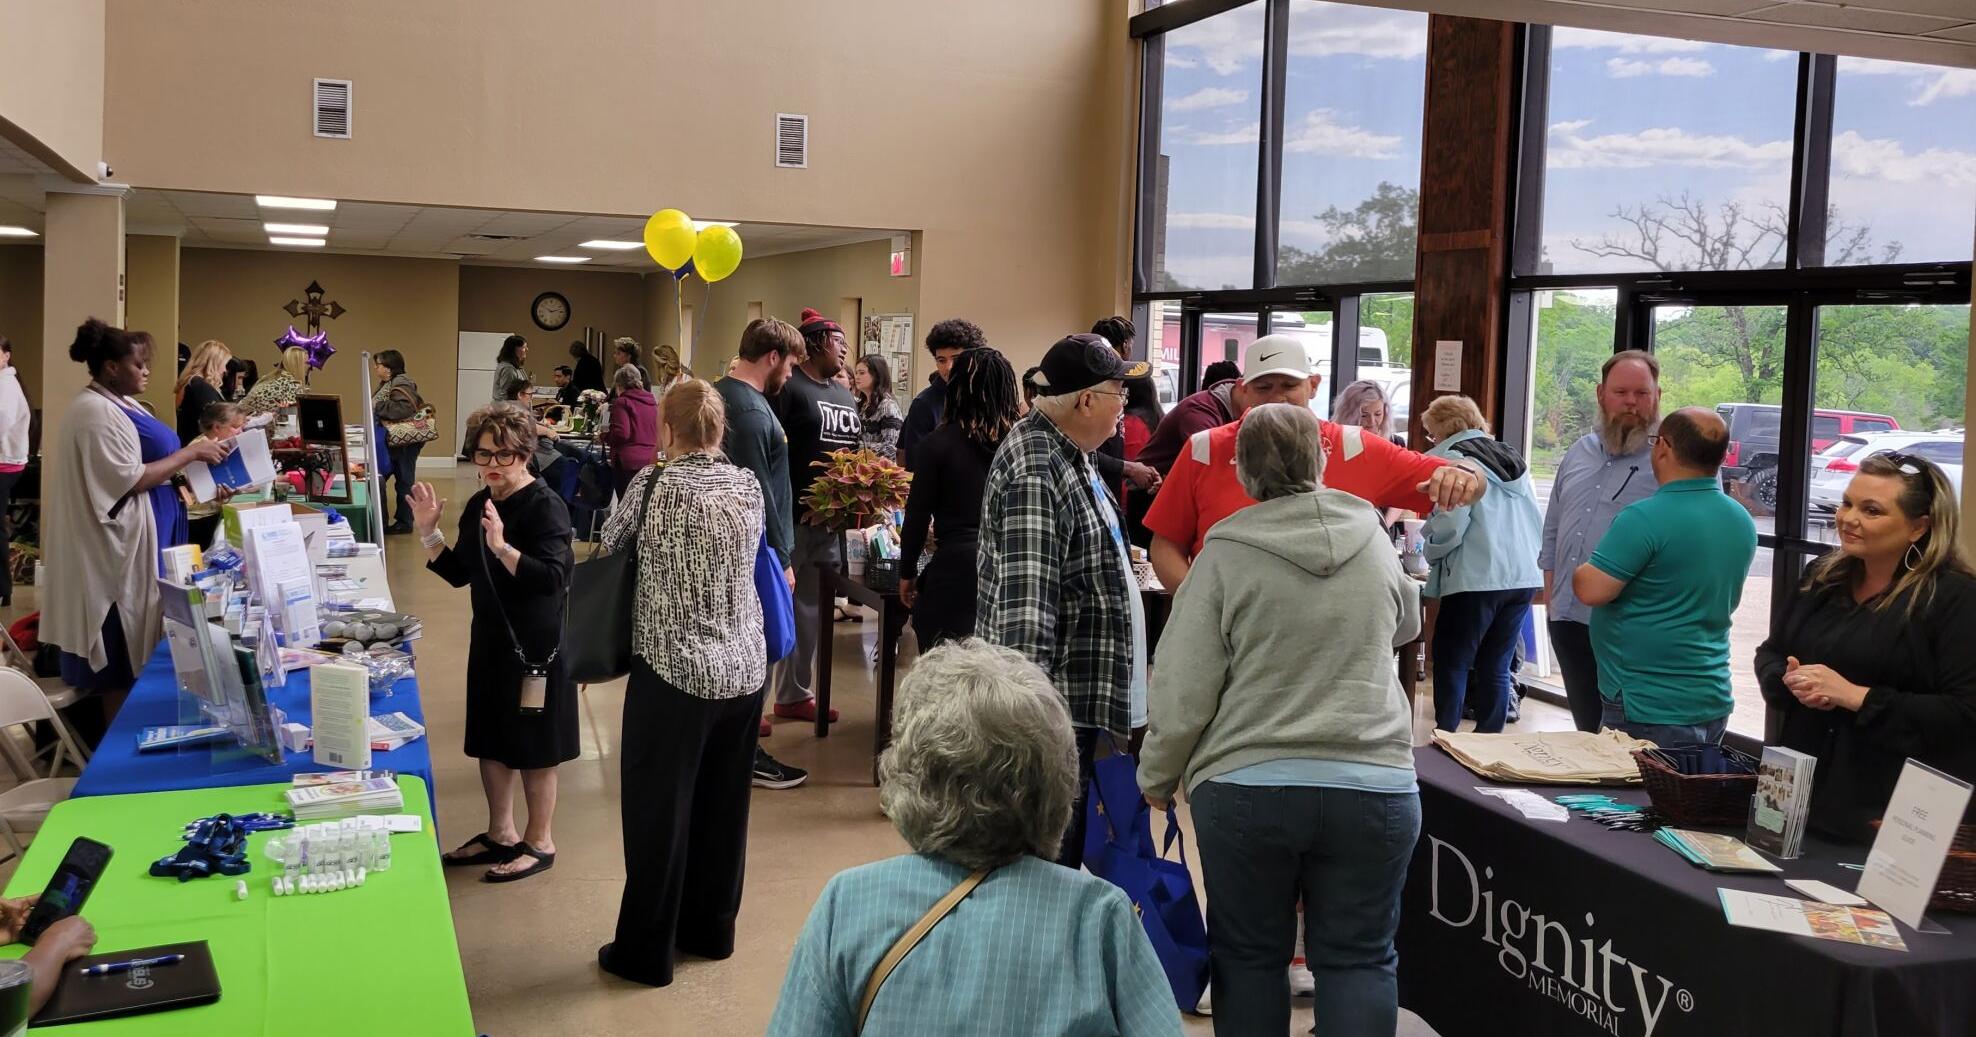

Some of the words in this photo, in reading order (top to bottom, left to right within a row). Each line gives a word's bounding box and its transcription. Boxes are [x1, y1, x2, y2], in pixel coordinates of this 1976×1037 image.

[822, 406, 860, 433] TVCC
[1911, 806, 1929, 821] FREE
[1528, 969, 1620, 1037] MEMORIAL
